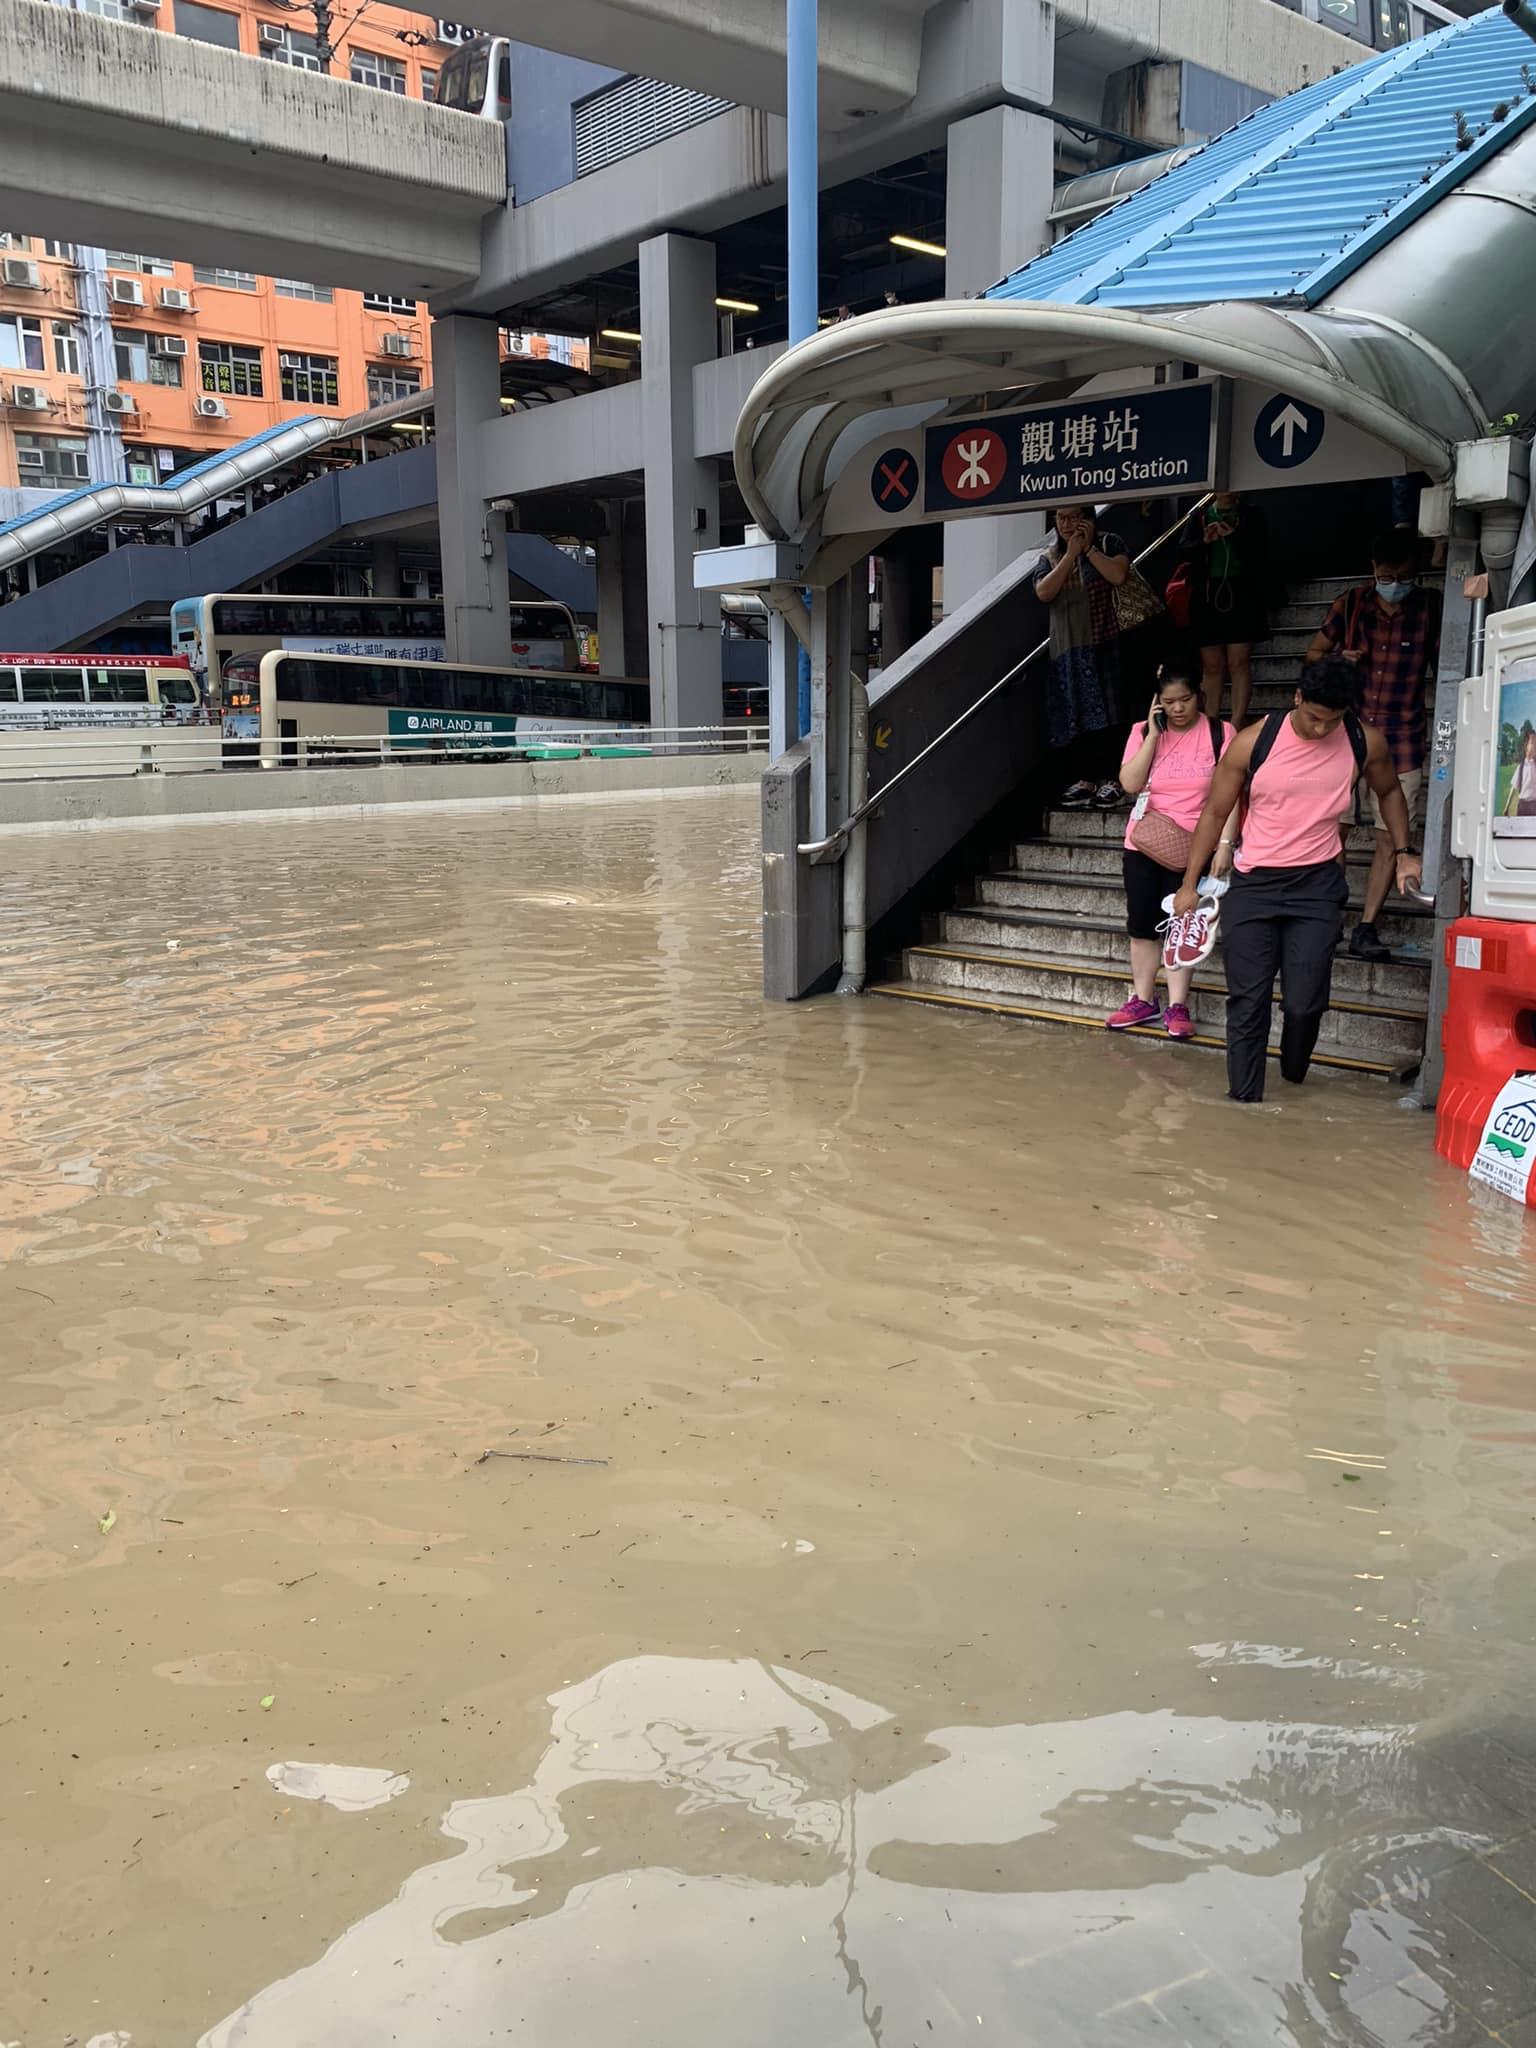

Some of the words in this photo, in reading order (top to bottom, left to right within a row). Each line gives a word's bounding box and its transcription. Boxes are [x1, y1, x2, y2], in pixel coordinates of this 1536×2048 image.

[1021, 407, 1140, 465] 觀塘站
[1020, 472, 1067, 493] Kwun
[1071, 466, 1116, 488] Tong
[1121, 456, 1188, 481] Station
[420, 717, 472, 731] AIRLAND
[1494, 1111, 1536, 1143] CEDD
